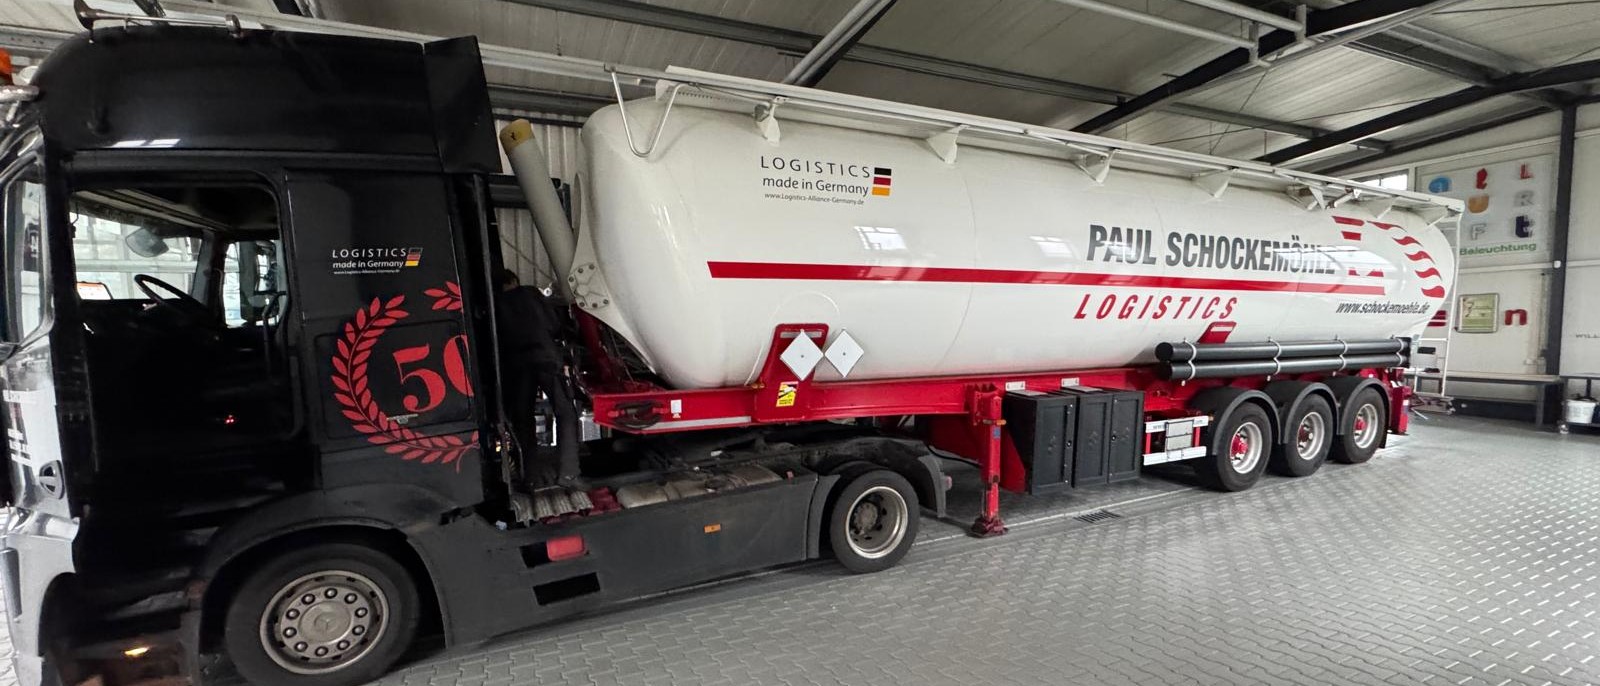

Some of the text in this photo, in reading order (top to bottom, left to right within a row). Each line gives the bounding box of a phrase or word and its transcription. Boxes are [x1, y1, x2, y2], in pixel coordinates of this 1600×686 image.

[760, 155, 870, 178] LOGISTICS
[762, 176, 869, 197] made in Germany
[332, 248, 406, 258] LOGISTICS
[1087, 224, 1157, 265] PAUL
[1459, 243, 1537, 256] Beleuchtung
[332, 259, 404, 269] made in Germany
[1073, 294, 1238, 319] LOGISTICS
[1335, 300, 1431, 314] www.schockemoehle.de
[392, 334, 474, 413] 50
